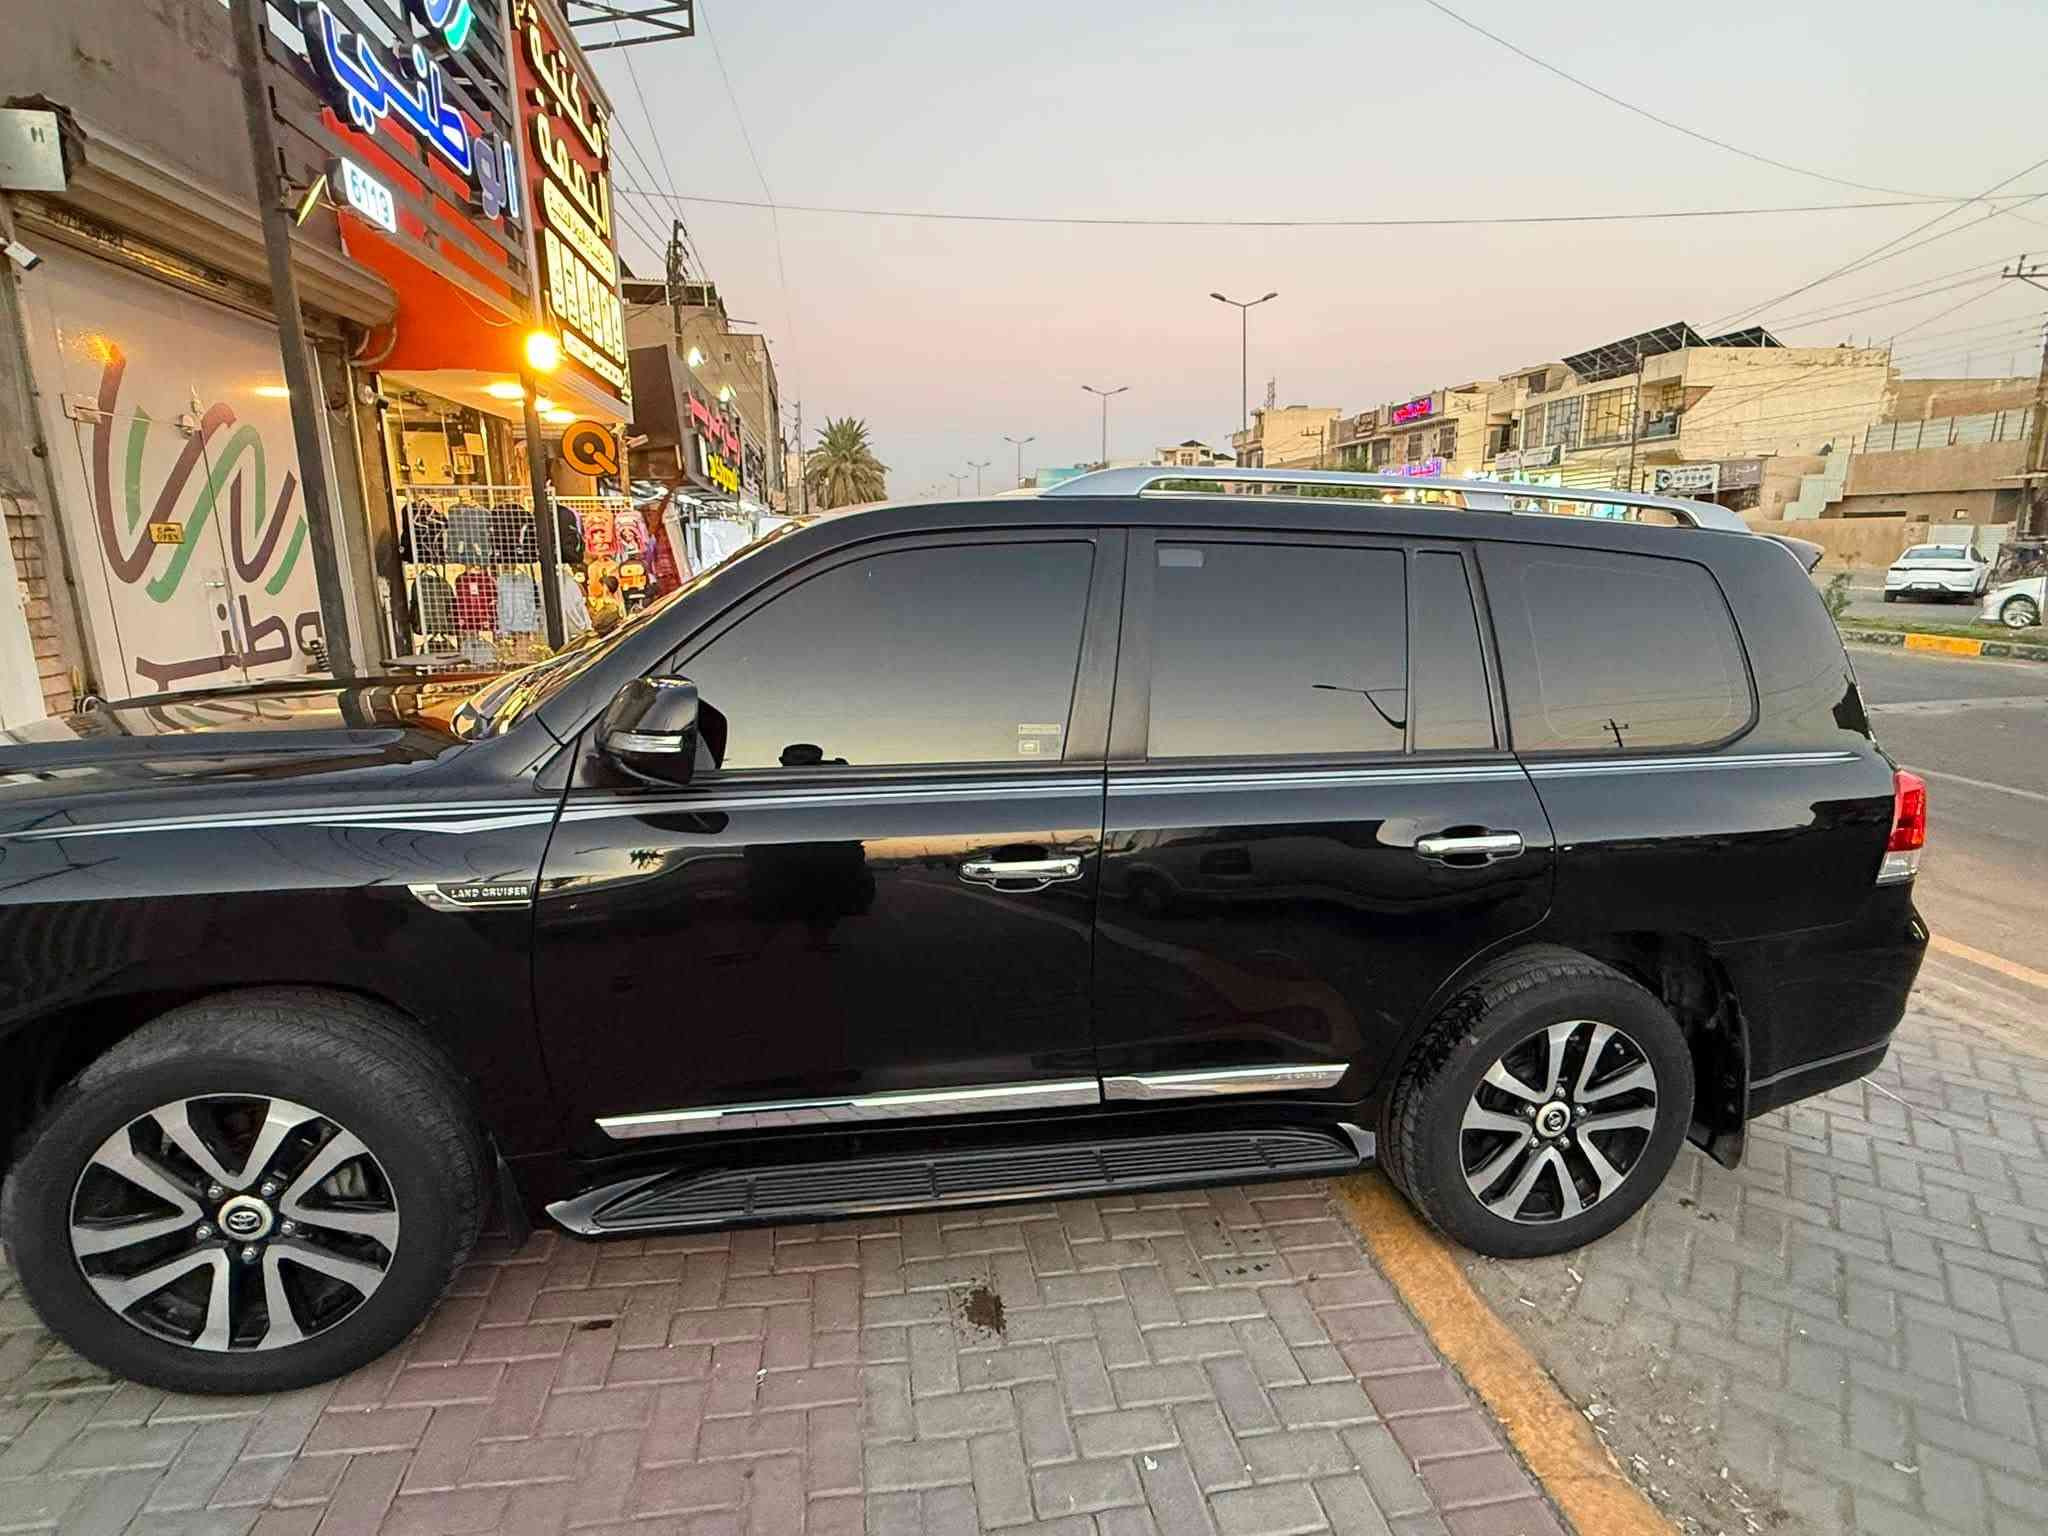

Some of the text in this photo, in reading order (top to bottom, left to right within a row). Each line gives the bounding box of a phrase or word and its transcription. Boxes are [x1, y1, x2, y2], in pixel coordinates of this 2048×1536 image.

[316, 3, 519, 220] الوطني
[451, 886, 528, 898] LAND CRUISER
